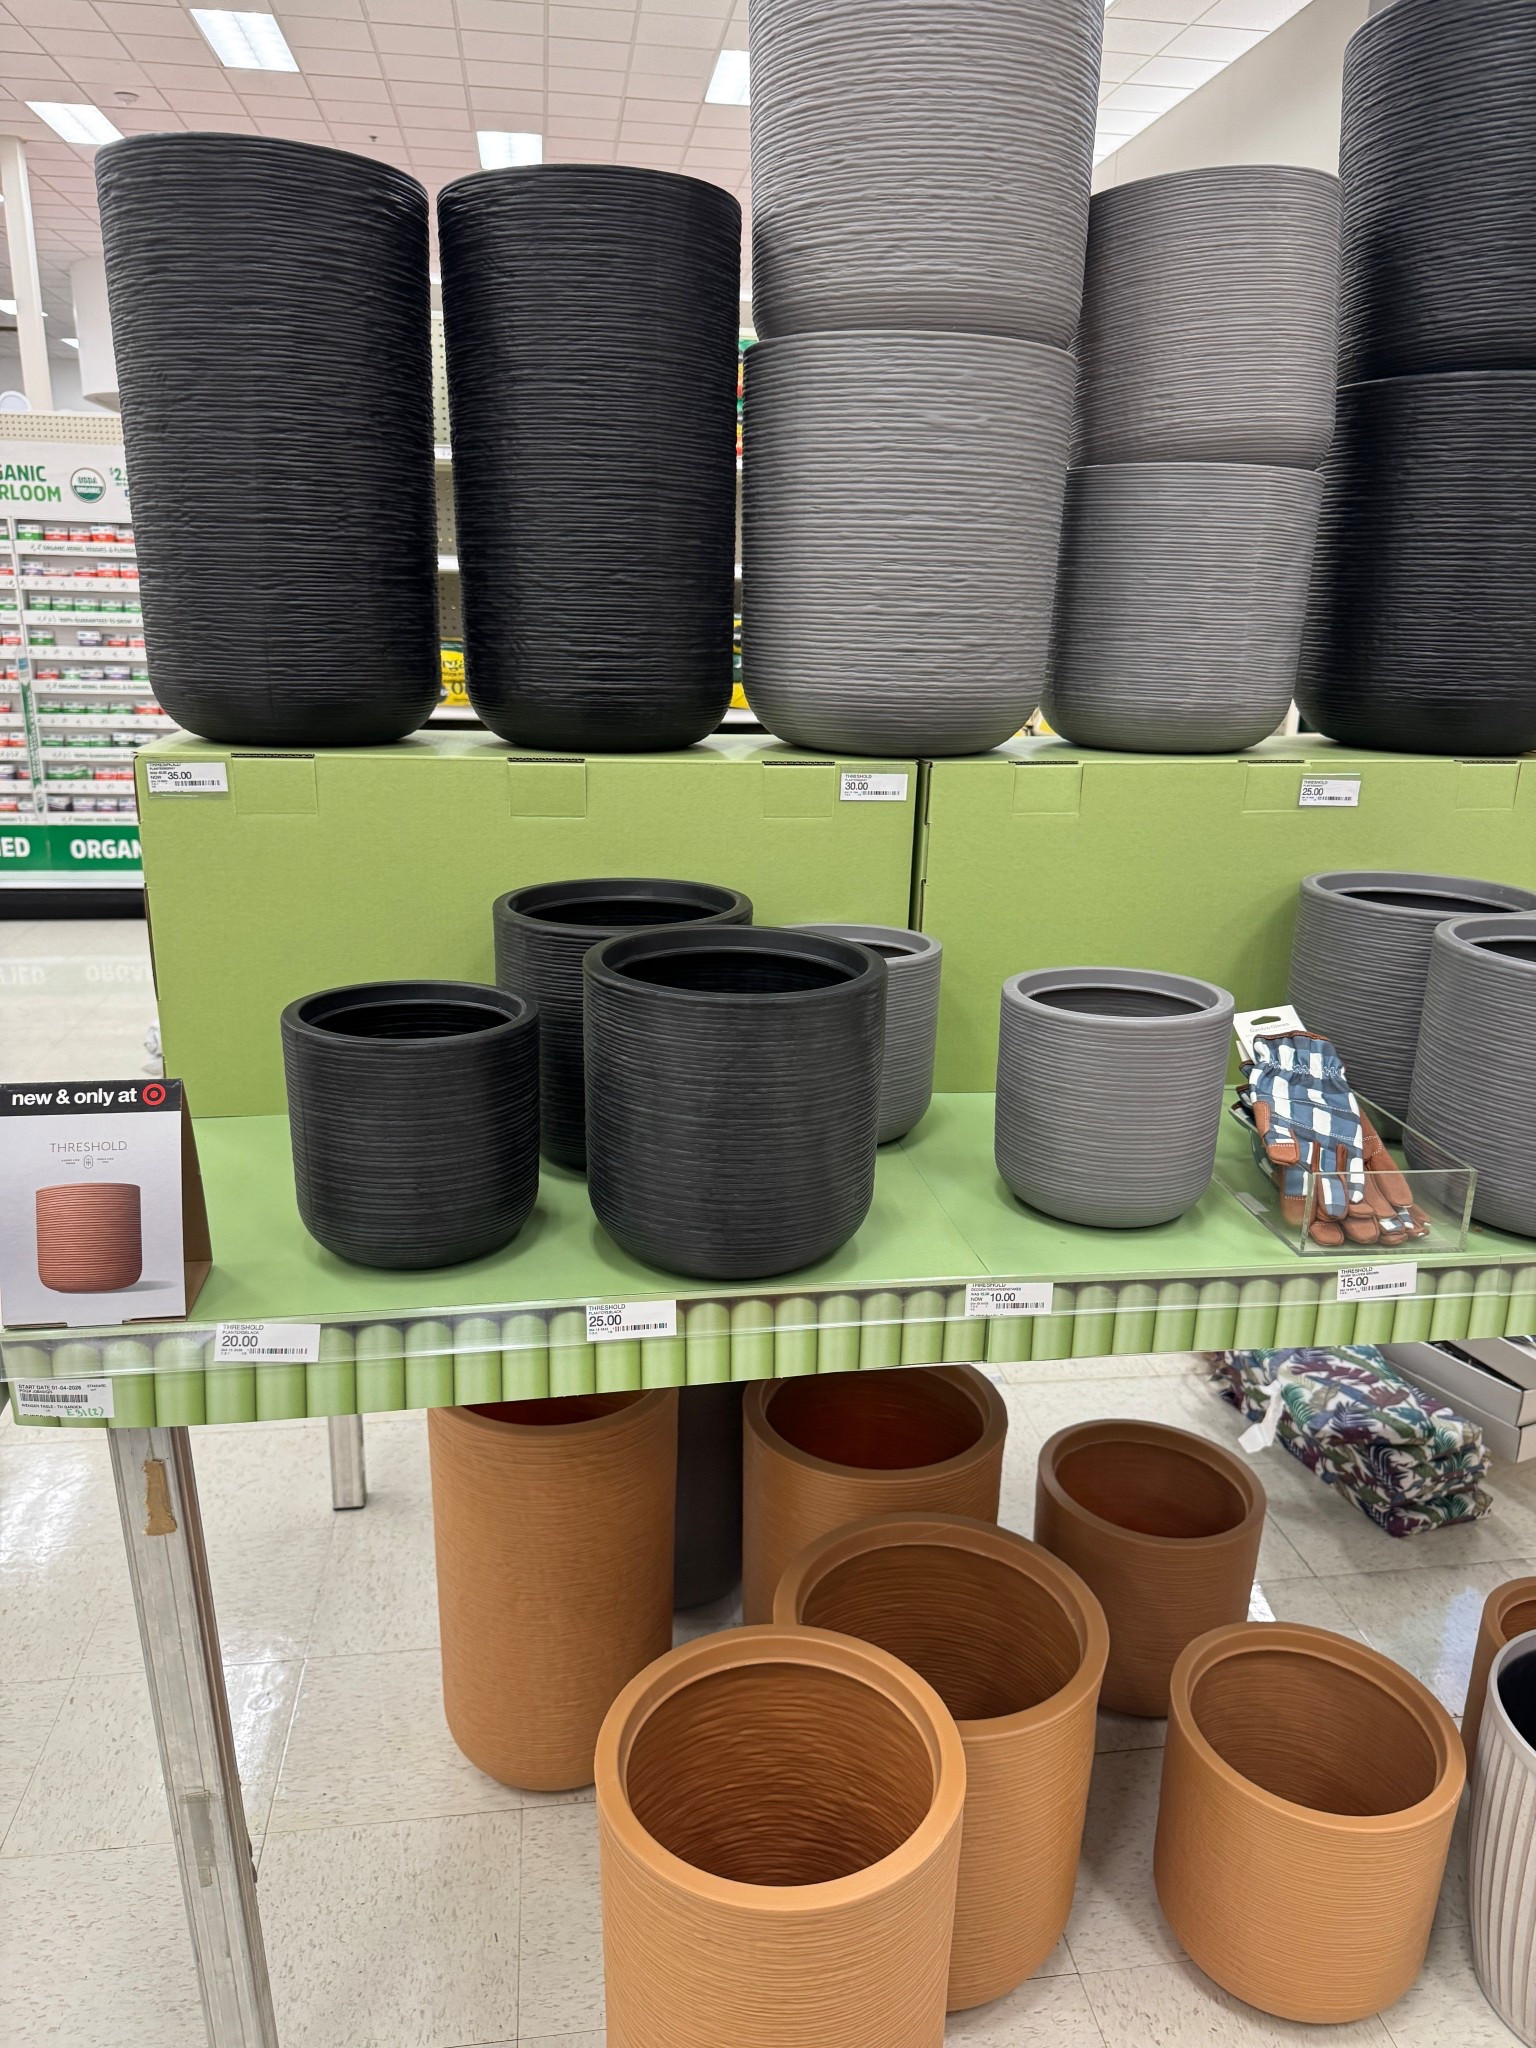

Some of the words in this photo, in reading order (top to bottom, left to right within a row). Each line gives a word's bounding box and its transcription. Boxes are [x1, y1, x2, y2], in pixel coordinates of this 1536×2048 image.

[167, 771, 192, 780] 35.00
[844, 781, 869, 790] 30.00
[1302, 787, 1324, 796] 25.00
[0, 836, 31, 858] ED
[12, 1092, 53, 1106] new
[56, 1089, 71, 1104] &
[74, 1087, 114, 1107] only
[118, 1087, 137, 1103] at
[50, 1140, 128, 1153] THRESHOLD
[1341, 1267, 1373, 1275] THRESHOLD
[1341, 1276, 1369, 1287] 15.00
[990, 1292, 1016, 1302] 10.00
[588, 1303, 626, 1311] THRESHOLD
[589, 1314, 622, 1327] 25.00
[221, 1335, 258, 1347] 20.00
